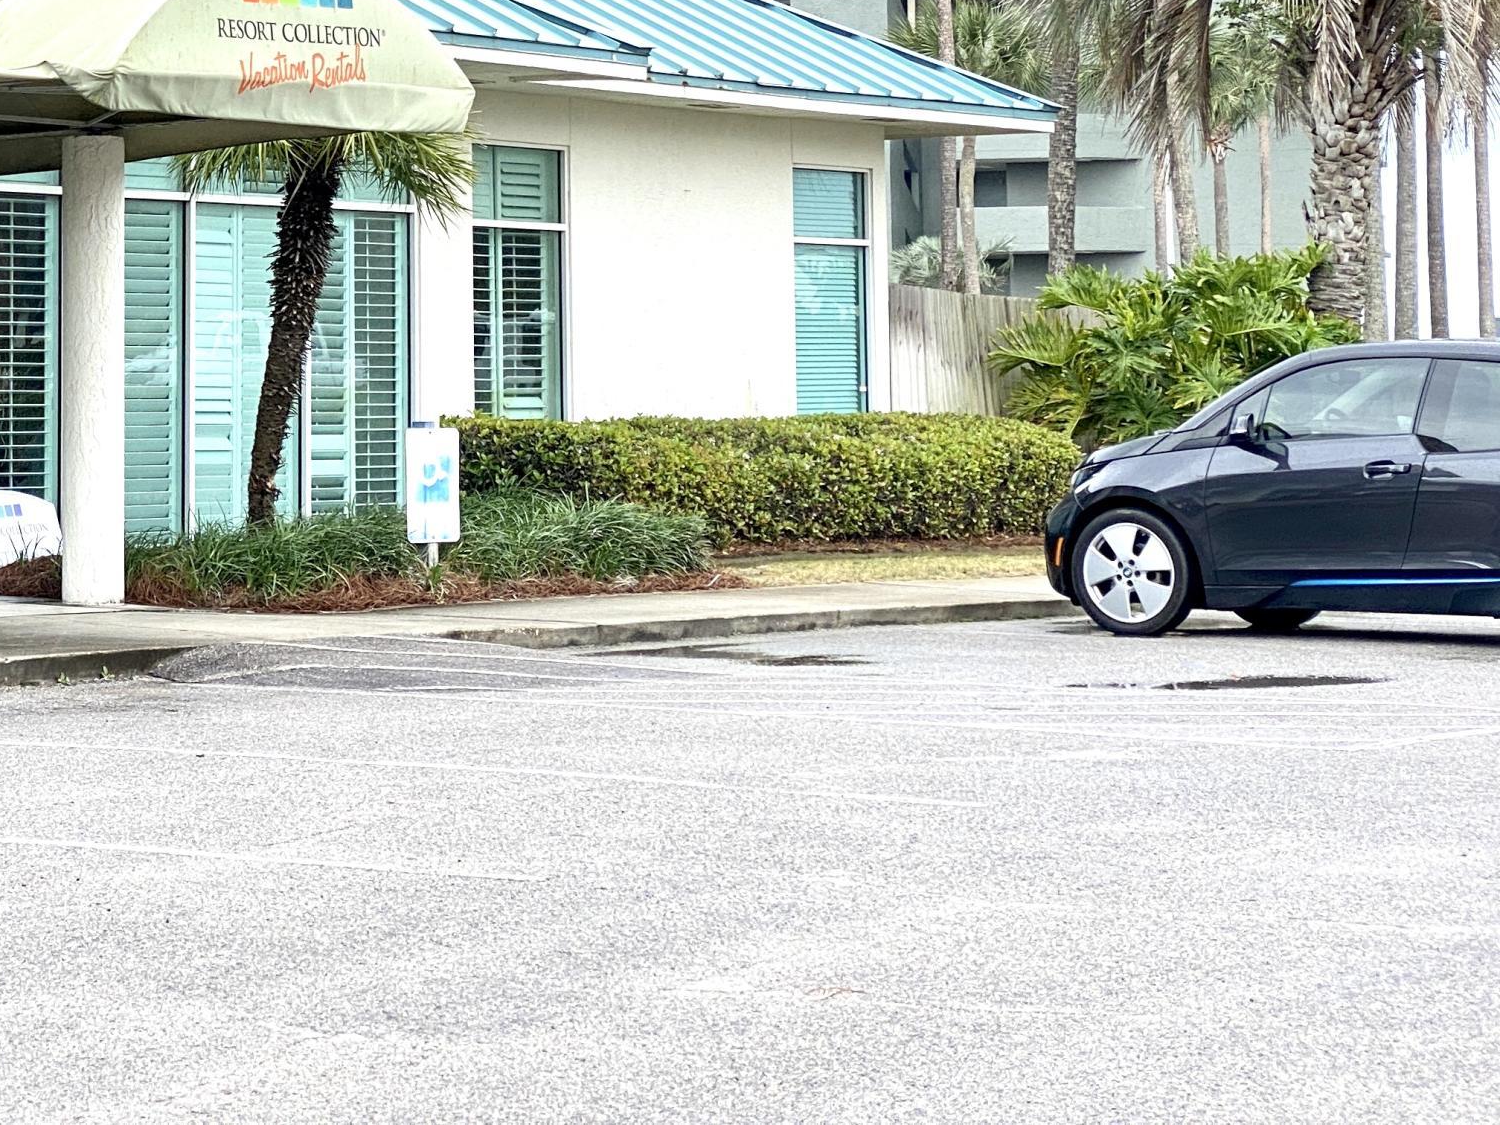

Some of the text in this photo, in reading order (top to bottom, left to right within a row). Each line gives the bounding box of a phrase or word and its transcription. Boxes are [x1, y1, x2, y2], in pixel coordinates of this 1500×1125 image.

[216, 17, 276, 42] RESORT
[237, 43, 367, 95] Vacation Rentals
